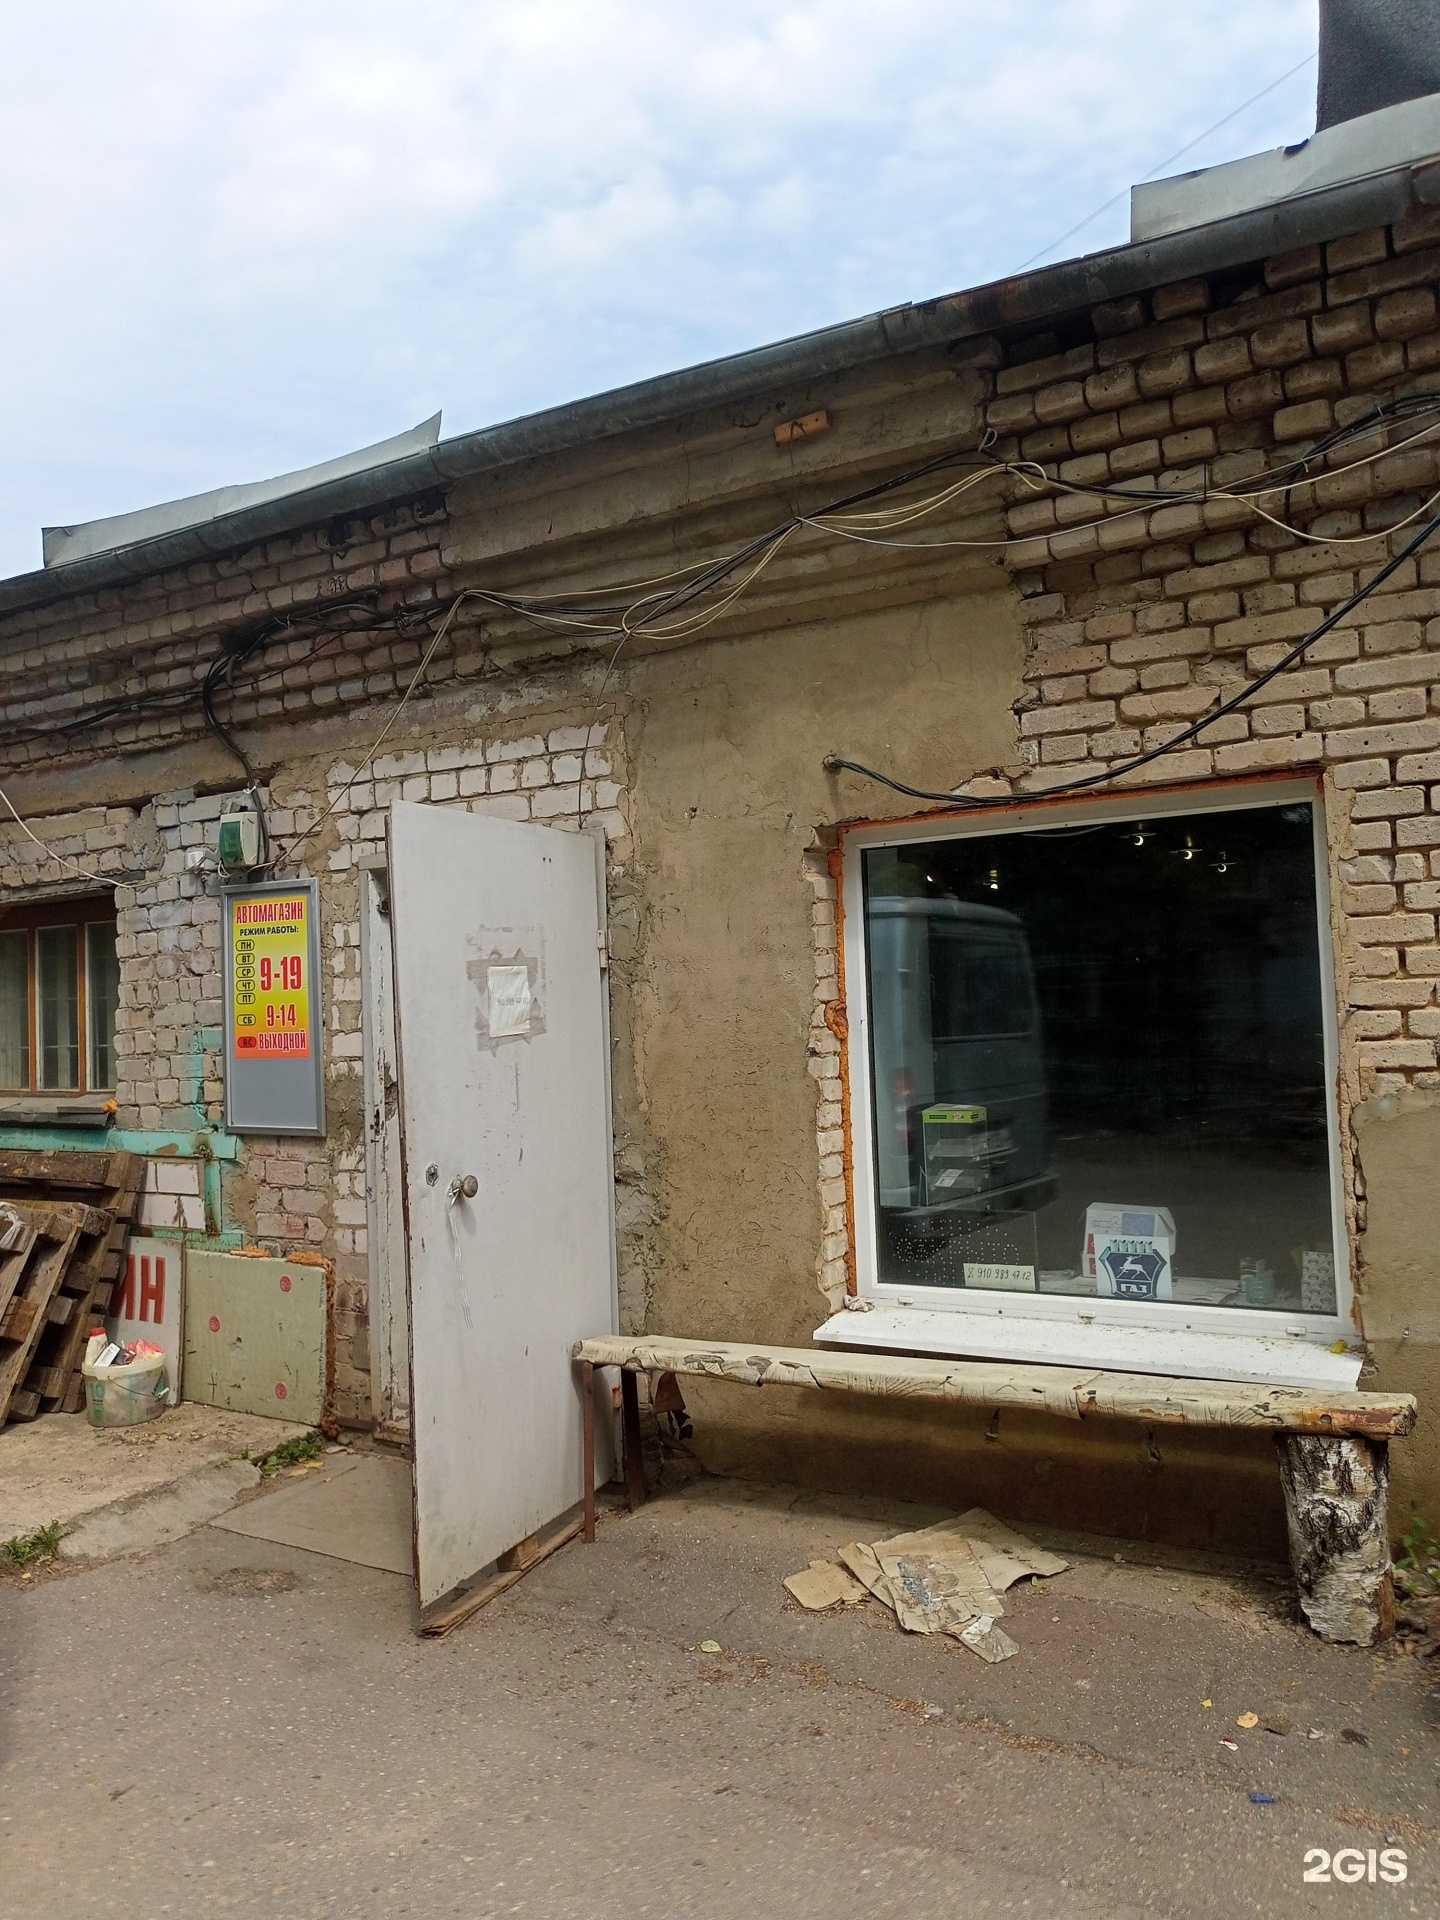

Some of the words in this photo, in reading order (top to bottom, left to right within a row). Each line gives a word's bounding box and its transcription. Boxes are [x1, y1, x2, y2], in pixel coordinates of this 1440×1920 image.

[236, 901, 303, 924] АВТОМАГАЗИН
[240, 927, 265, 936] РЕЖИМ
[267, 925, 299, 935] РАБОТЫ:
[240, 942, 252, 950] ПН
[242, 955, 251, 963] ВТ
[241, 968, 251, 976] СР
[260, 956, 302, 991] 9-19
[242, 981, 251, 989] ЧТ
[242, 995, 252, 1003] ПТ
[242, 1016, 253, 1024] СБ
[266, 1004, 296, 1027] 9-14
[259, 1030, 306, 1050] ВЫХОДНОЙ
